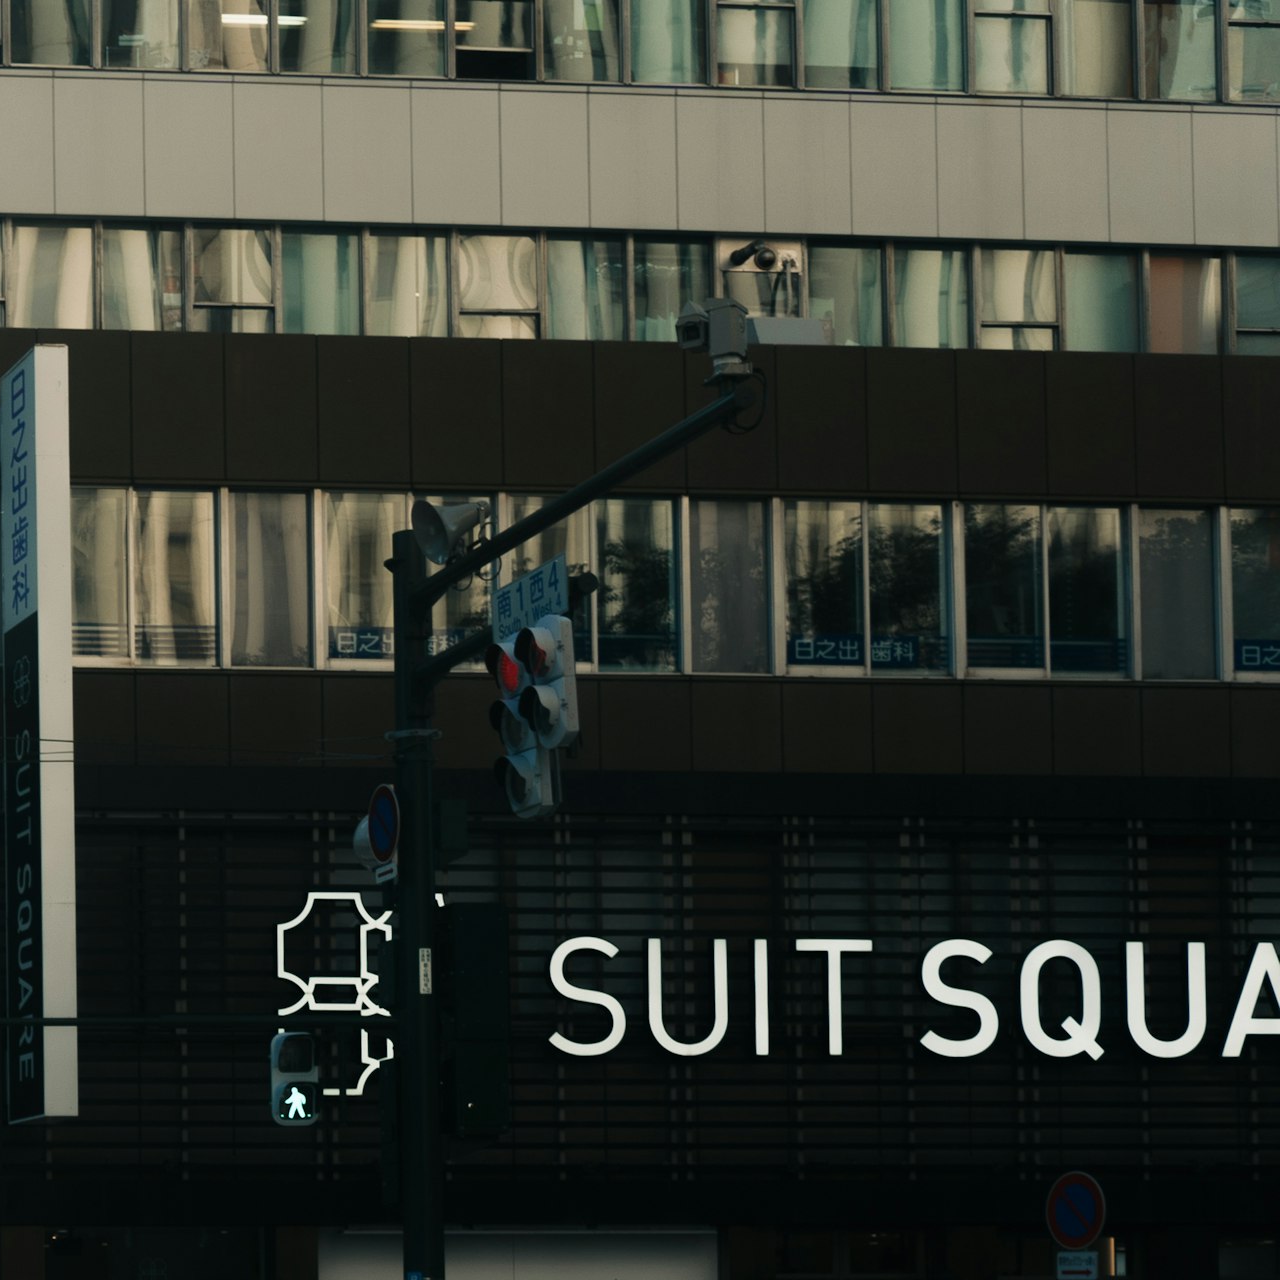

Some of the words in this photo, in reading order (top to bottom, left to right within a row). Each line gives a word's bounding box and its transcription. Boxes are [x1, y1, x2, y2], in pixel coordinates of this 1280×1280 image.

[10, 368, 30, 613] 日之出歯科
[497, 561, 560, 622] 南1西4
[794, 638, 859, 661] 日之出
[871, 640, 914, 663] 歯科
[14, 729, 31, 847] SUIT
[16, 863, 34, 1084] SQUARE
[548, 936, 874, 1057] SUIT
[919, 938, 1280, 1062] SQUA
